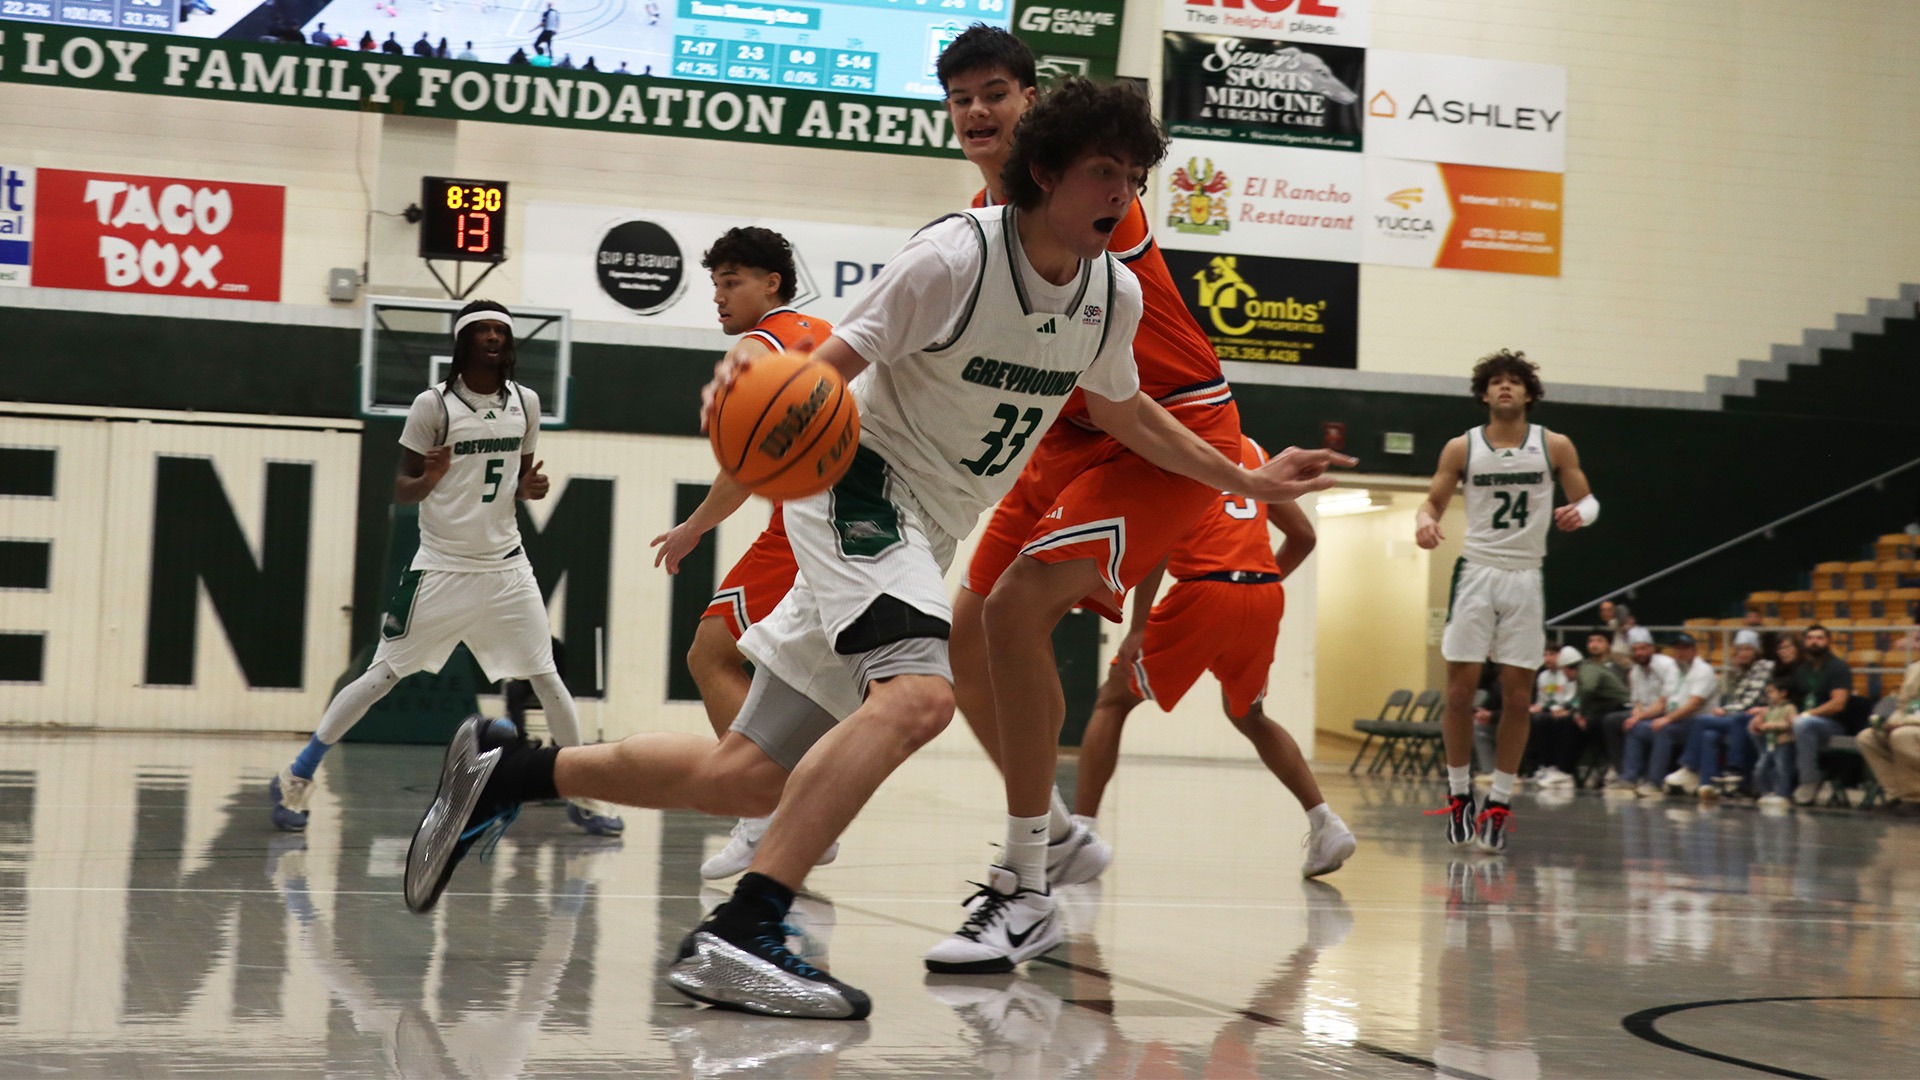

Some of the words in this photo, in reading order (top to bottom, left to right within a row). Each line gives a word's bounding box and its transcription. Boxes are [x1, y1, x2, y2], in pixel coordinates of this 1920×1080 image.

[1051, 21, 1095, 36] ONE
[1052, 9, 1115, 26] GAME
[1186, 10, 1218, 24] The
[1223, 14, 1283, 30] helpful
[1289, 20, 1339, 35] place.
[681, 40, 717, 56] 7-17
[737, 45, 764, 60] 2-3
[836, 54, 872, 70] 5-14
[21, 32, 148, 82] LOY
[163, 45, 402, 103] FAMILY
[415, 67, 787, 134] FOUNDATION
[1225, 67, 1313, 92] SPORTS
[1205, 86, 1326, 114] MEDICINE
[1200, 107, 1212, 118] &
[1216, 109, 1278, 123] URGENT
[1282, 113, 1325, 127] CARE
[447, 185, 501, 212] 8:30
[1243, 177, 1269, 197] El
[1273, 179, 1351, 203] Rancho
[84, 179, 232, 235] TACO
[1239, 203, 1354, 230] Restaurant
[457, 212, 490, 252] 13
[1374, 215, 1436, 232] YUCCA
[98, 235, 223, 289] BOX
[1256, 321, 1325, 333] PROPERTIES
[958, 402, 1043, 477] 33
[482, 459, 504, 502] 5
[1492, 490, 1529, 529] 24
